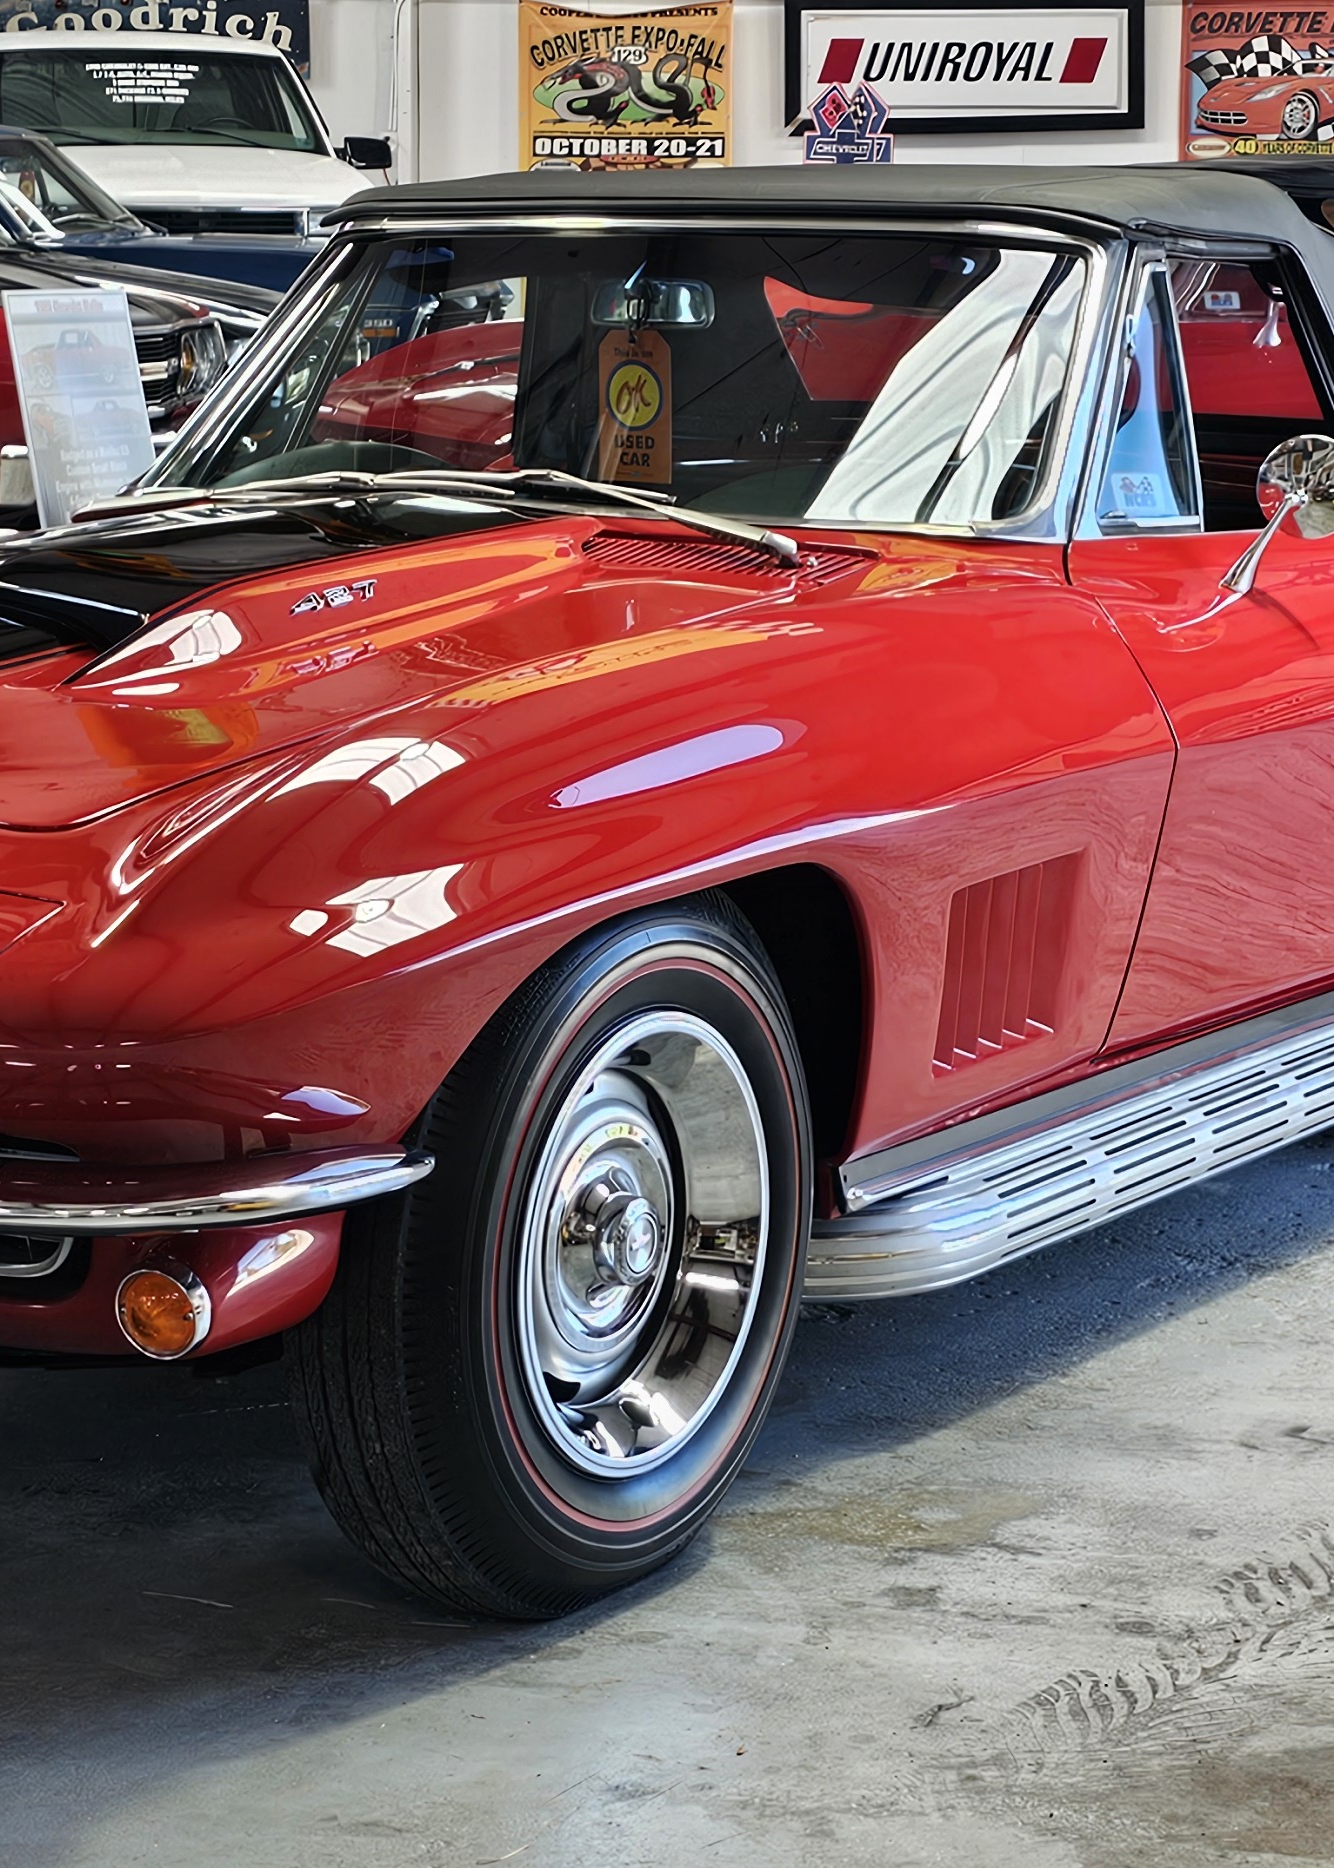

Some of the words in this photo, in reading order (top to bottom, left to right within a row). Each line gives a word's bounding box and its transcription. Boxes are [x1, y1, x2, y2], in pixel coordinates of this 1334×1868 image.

[5, 0, 294, 51] Goodrich
[1190, 11, 1328, 34] CORVETTE
[530, 25, 625, 67] CORVETTE
[863, 41, 1054, 82] UNIROYAL
[534, 137, 649, 156] OCTOBER
[653, 138, 724, 156] 20-21
[1234, 139, 1256, 154] 40
[615, 374, 652, 416] OK
[613, 434, 656, 450] USED
[619, 452, 651, 468] CAR
[288, 579, 378, 617] 427
